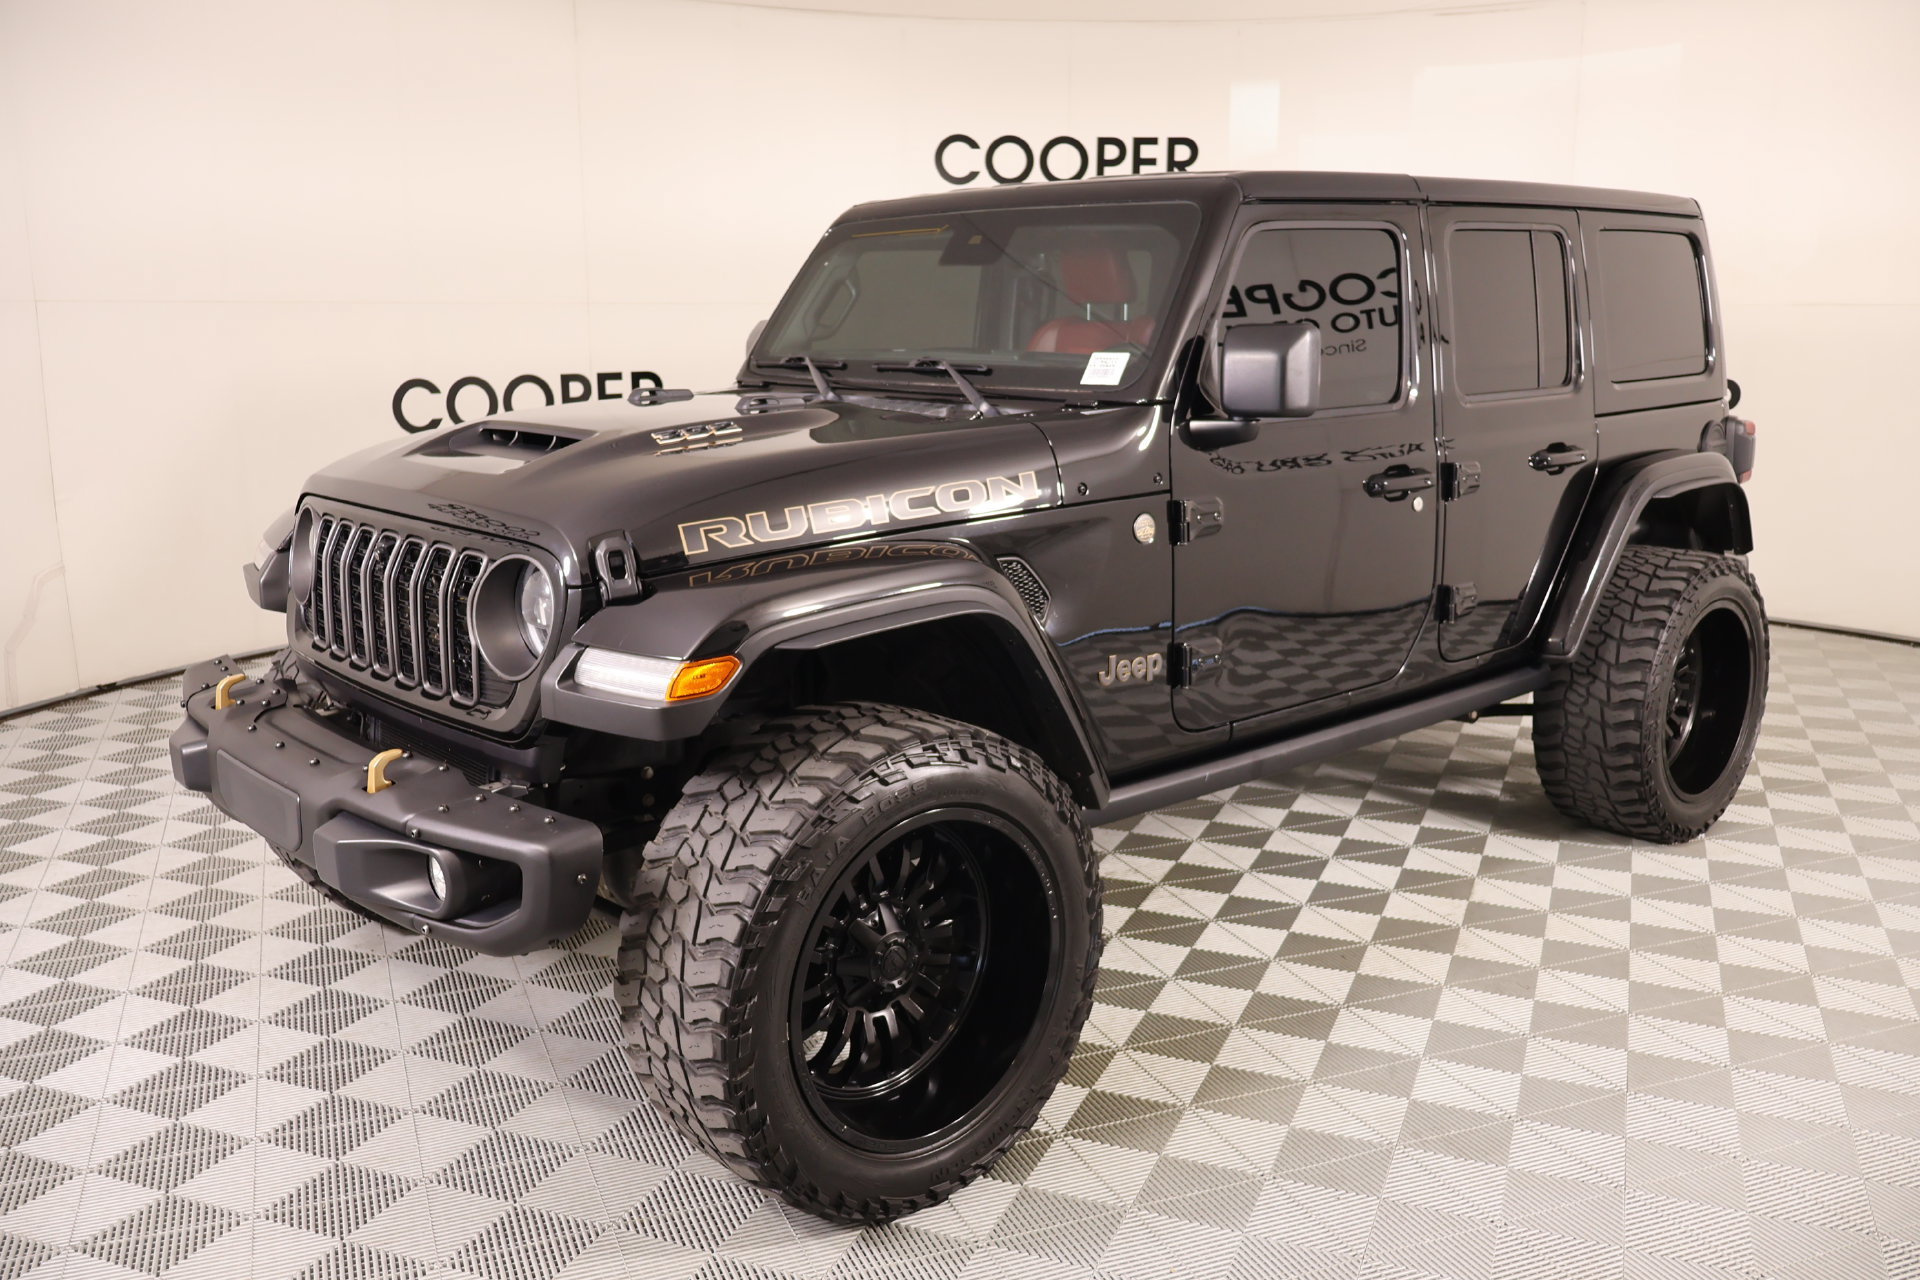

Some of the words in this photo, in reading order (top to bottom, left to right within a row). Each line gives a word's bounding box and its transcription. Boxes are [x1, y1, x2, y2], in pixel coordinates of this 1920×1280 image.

[935, 134, 1199, 186] COOPER
[677, 470, 1040, 556] RUBICON
[1098, 652, 1163, 686] Jeep
[861, 779, 928, 828] BOSS
